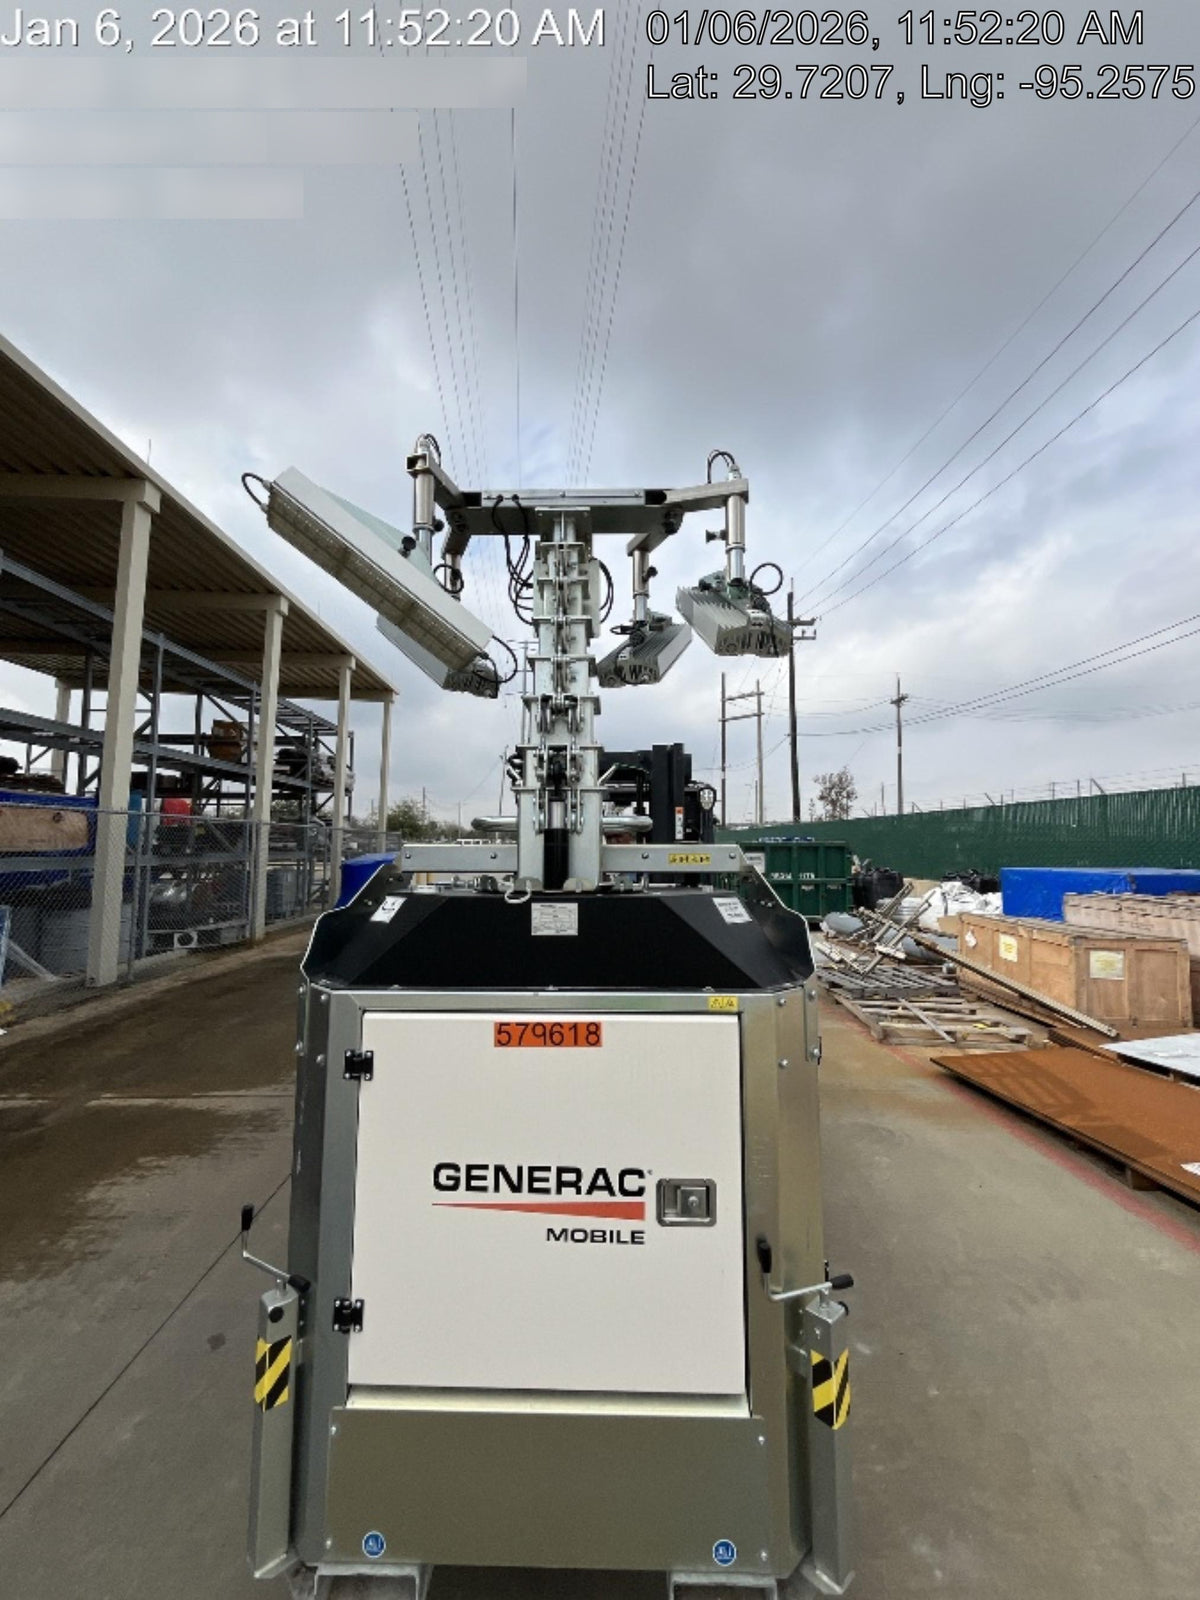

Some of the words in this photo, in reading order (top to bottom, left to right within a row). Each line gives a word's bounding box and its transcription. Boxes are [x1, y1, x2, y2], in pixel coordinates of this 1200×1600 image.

[496, 1022, 600, 1046] 579618
[432, 1162, 646, 1198] GENERAC
[546, 1227, 646, 1245] MOBILE
